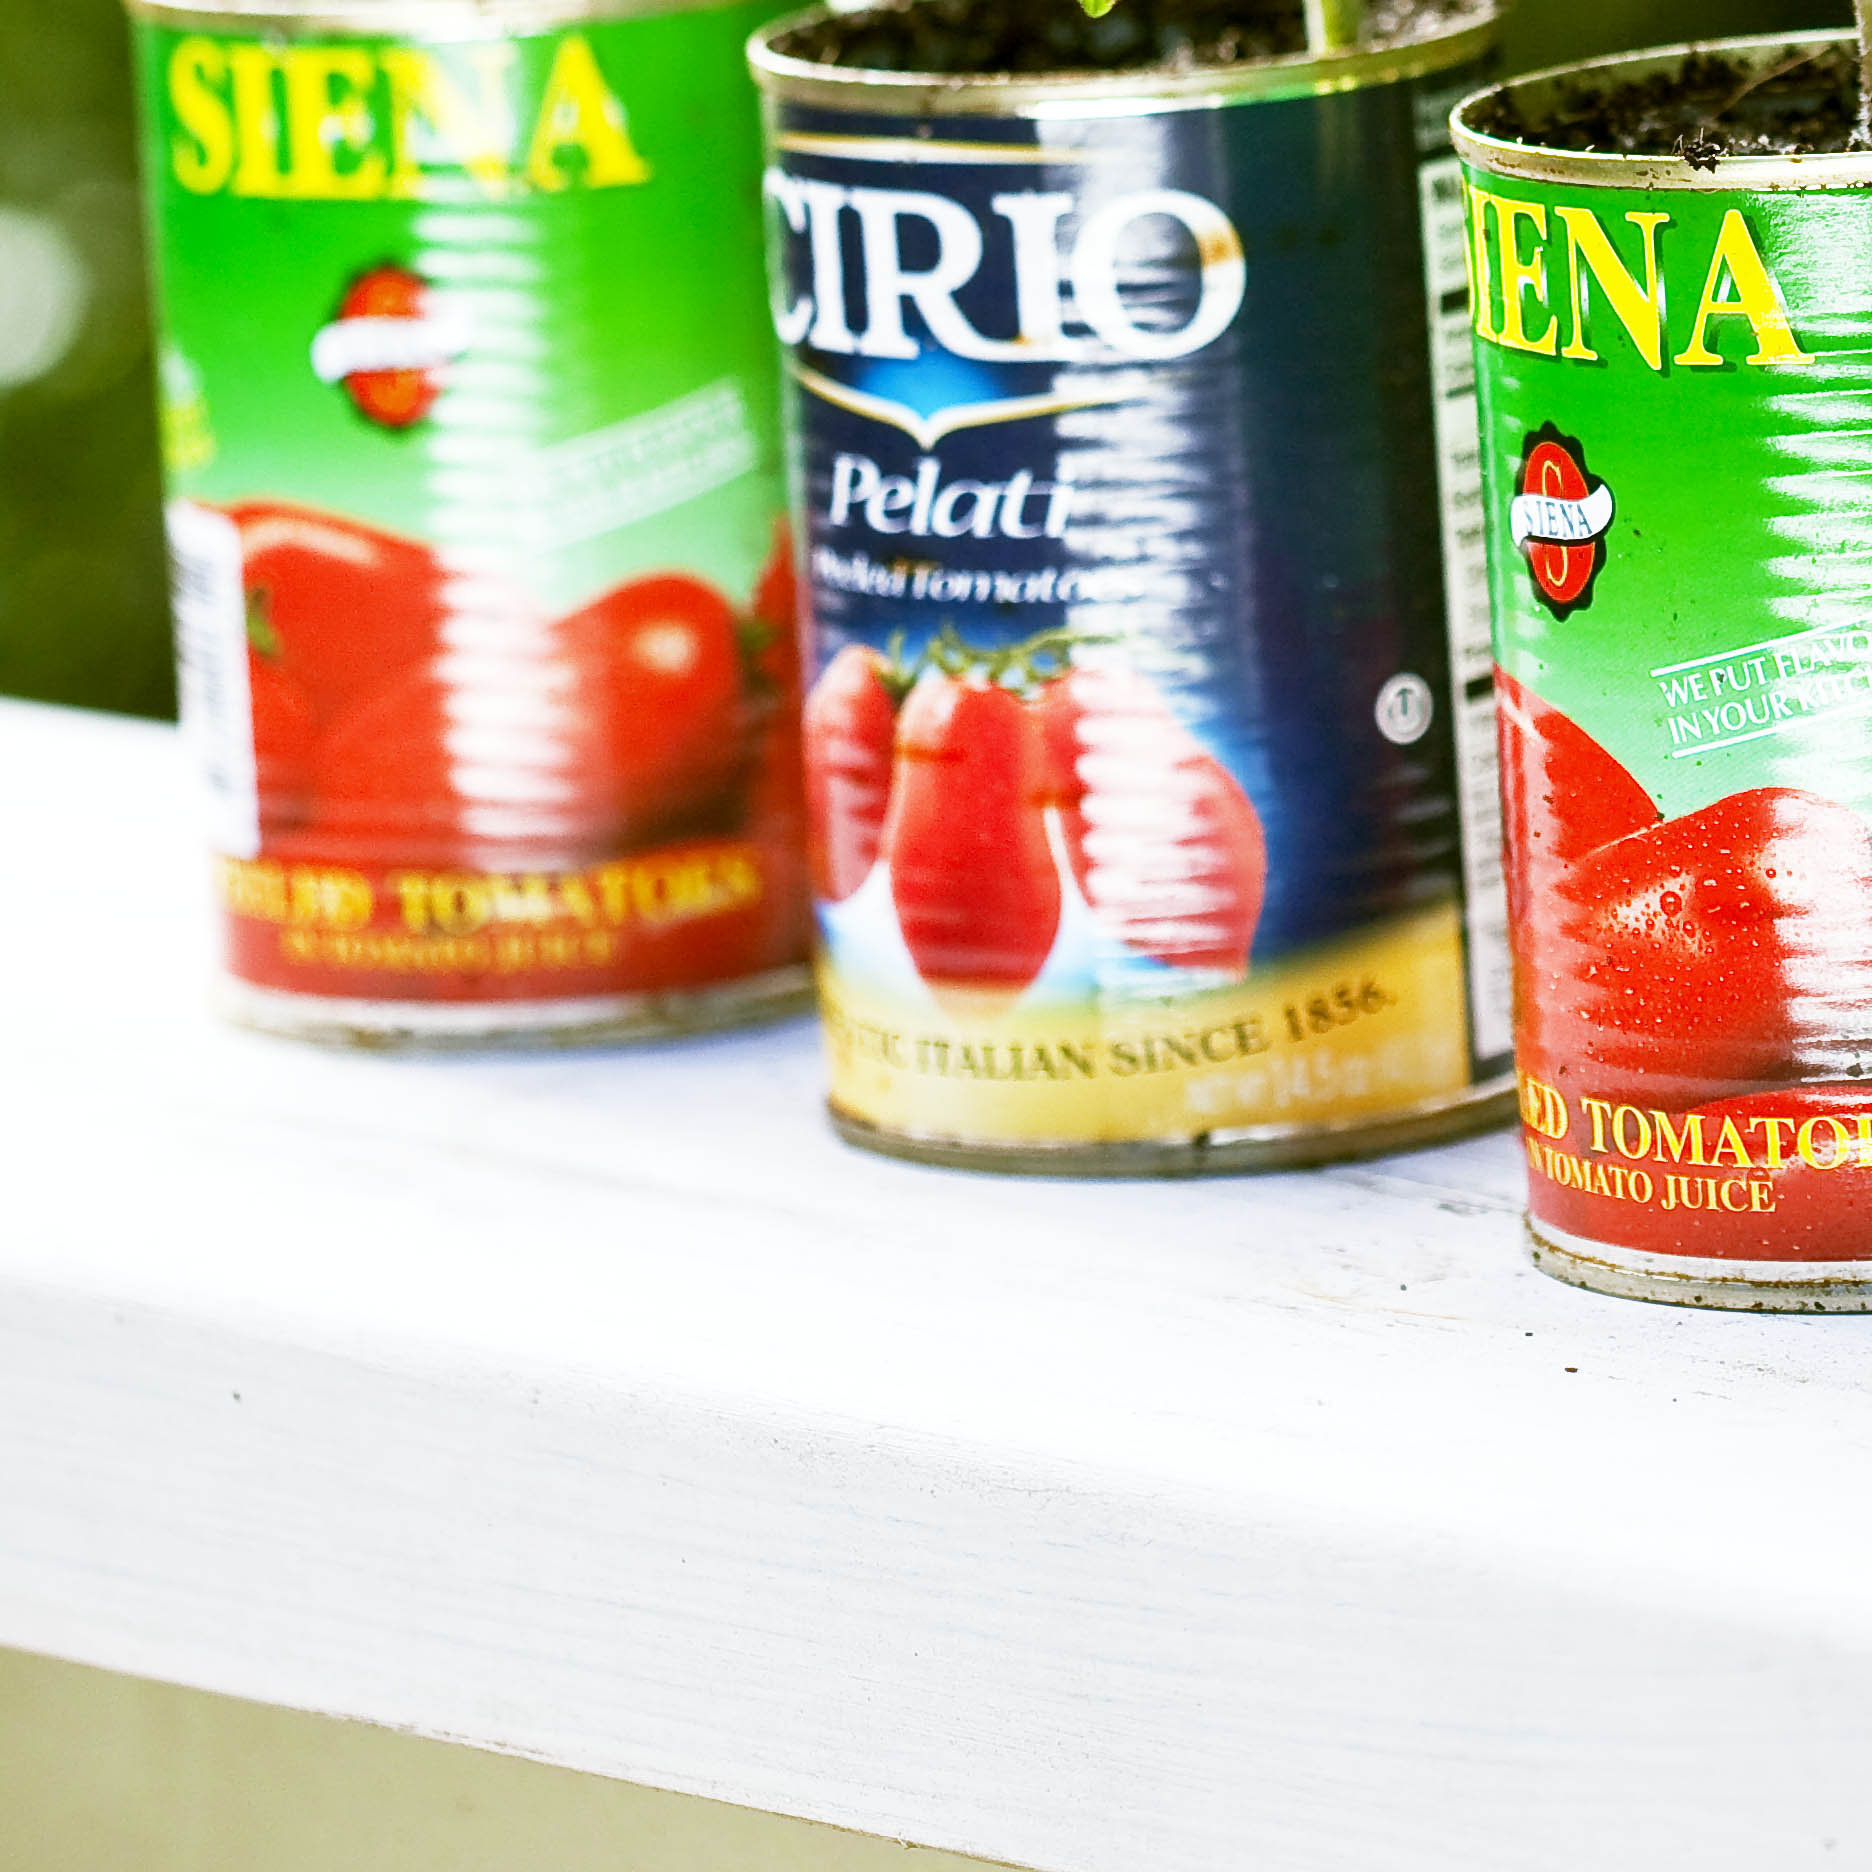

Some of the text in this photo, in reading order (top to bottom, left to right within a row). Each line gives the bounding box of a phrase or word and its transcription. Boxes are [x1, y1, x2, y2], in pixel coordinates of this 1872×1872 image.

[169, 32, 652, 200] SIENA
[762, 165, 1247, 362] CIRIO
[1462, 178, 1815, 370] IENA
[829, 451, 1080, 539] Pelati
[1523, 500, 1593, 539] SIENA
[1659, 673, 1708, 708] WE
[1709, 657, 1770, 697] PUT
[1667, 712, 1703, 745] IN
[1702, 691, 1794, 736] YOUR
[914, 1037, 1099, 1083] ITALIAN
[1110, 1016, 1272, 1078] SINCE
[1544, 1144, 1653, 1204] TOMATO
[1661, 1174, 1778, 1213] JUICE
